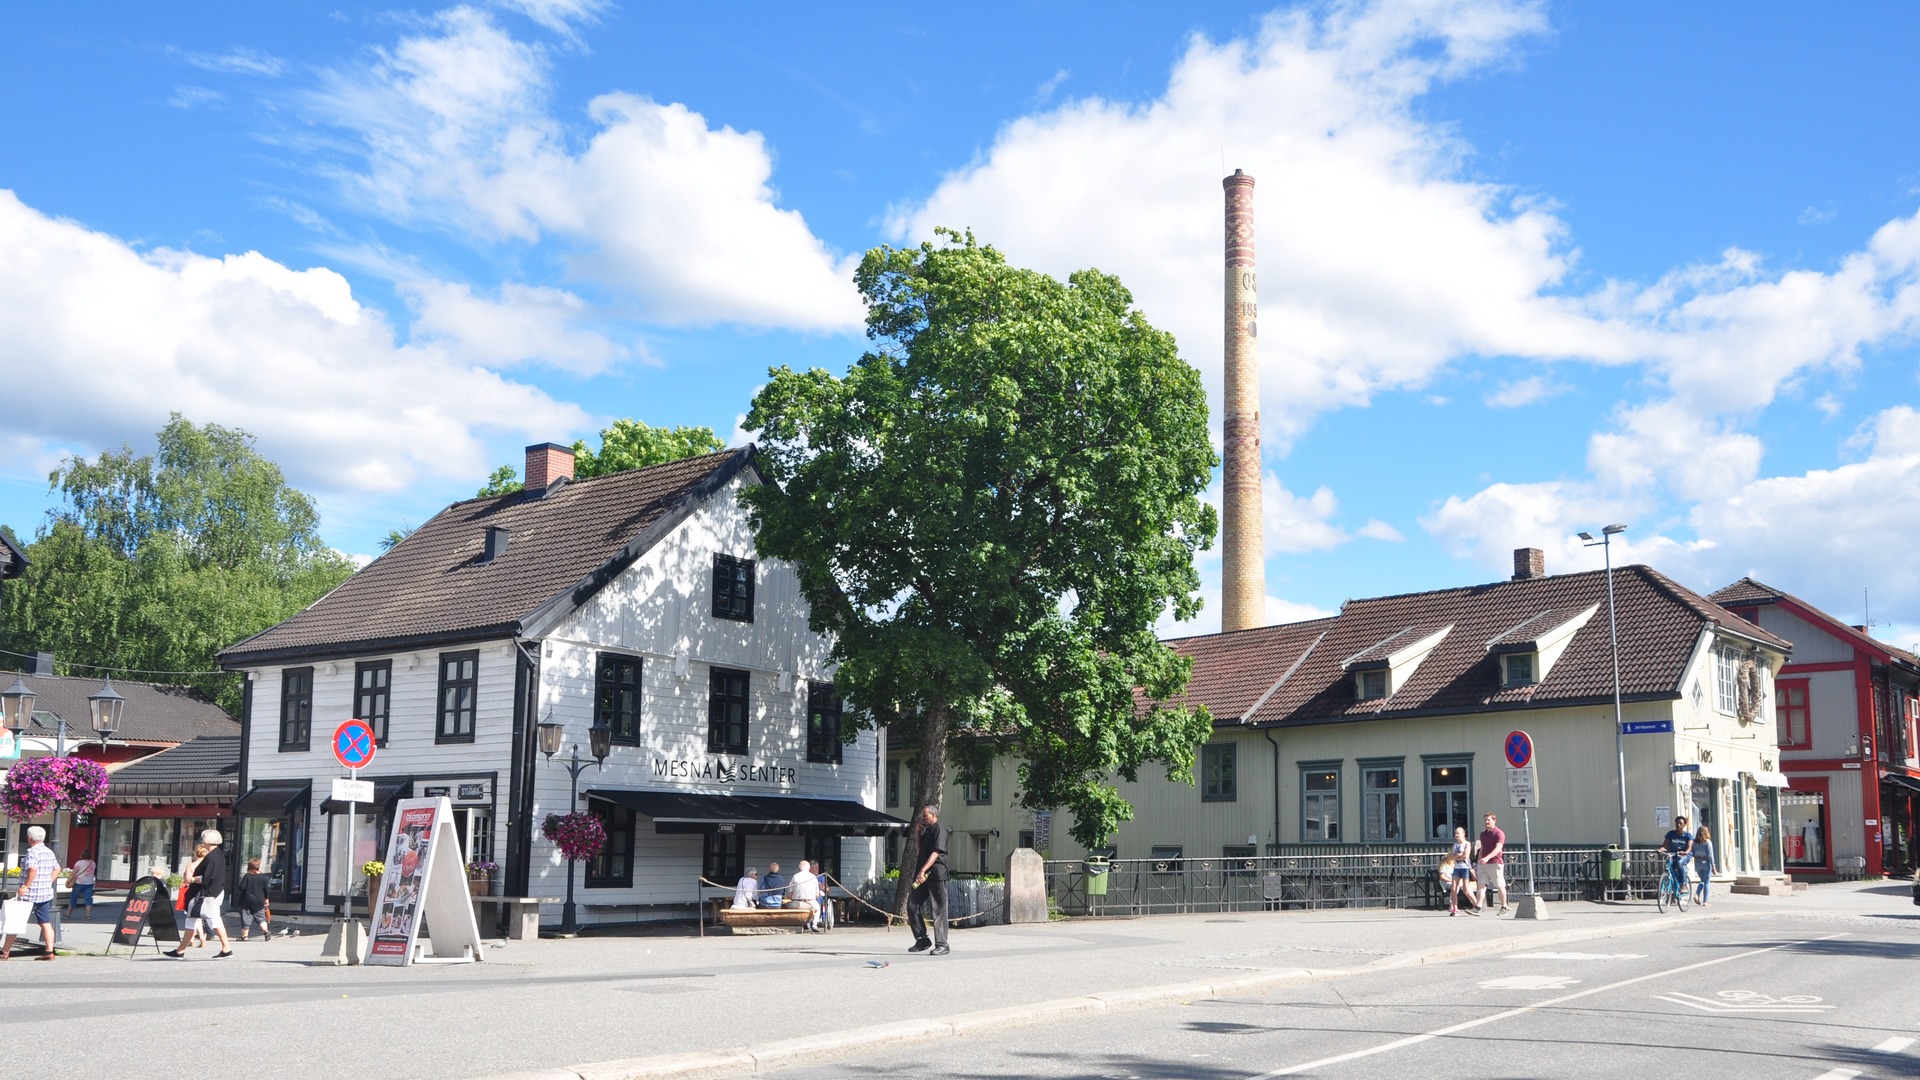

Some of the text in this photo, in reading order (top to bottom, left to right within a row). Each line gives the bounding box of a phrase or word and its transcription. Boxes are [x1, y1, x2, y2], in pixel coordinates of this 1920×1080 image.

[654, 759, 796, 783] MESNA SENTER
[1035, 817, 1043, 853] TERRASS
[1042, 816, 1051, 850] NIKKERS
[127, 899, 149, 914] 100
